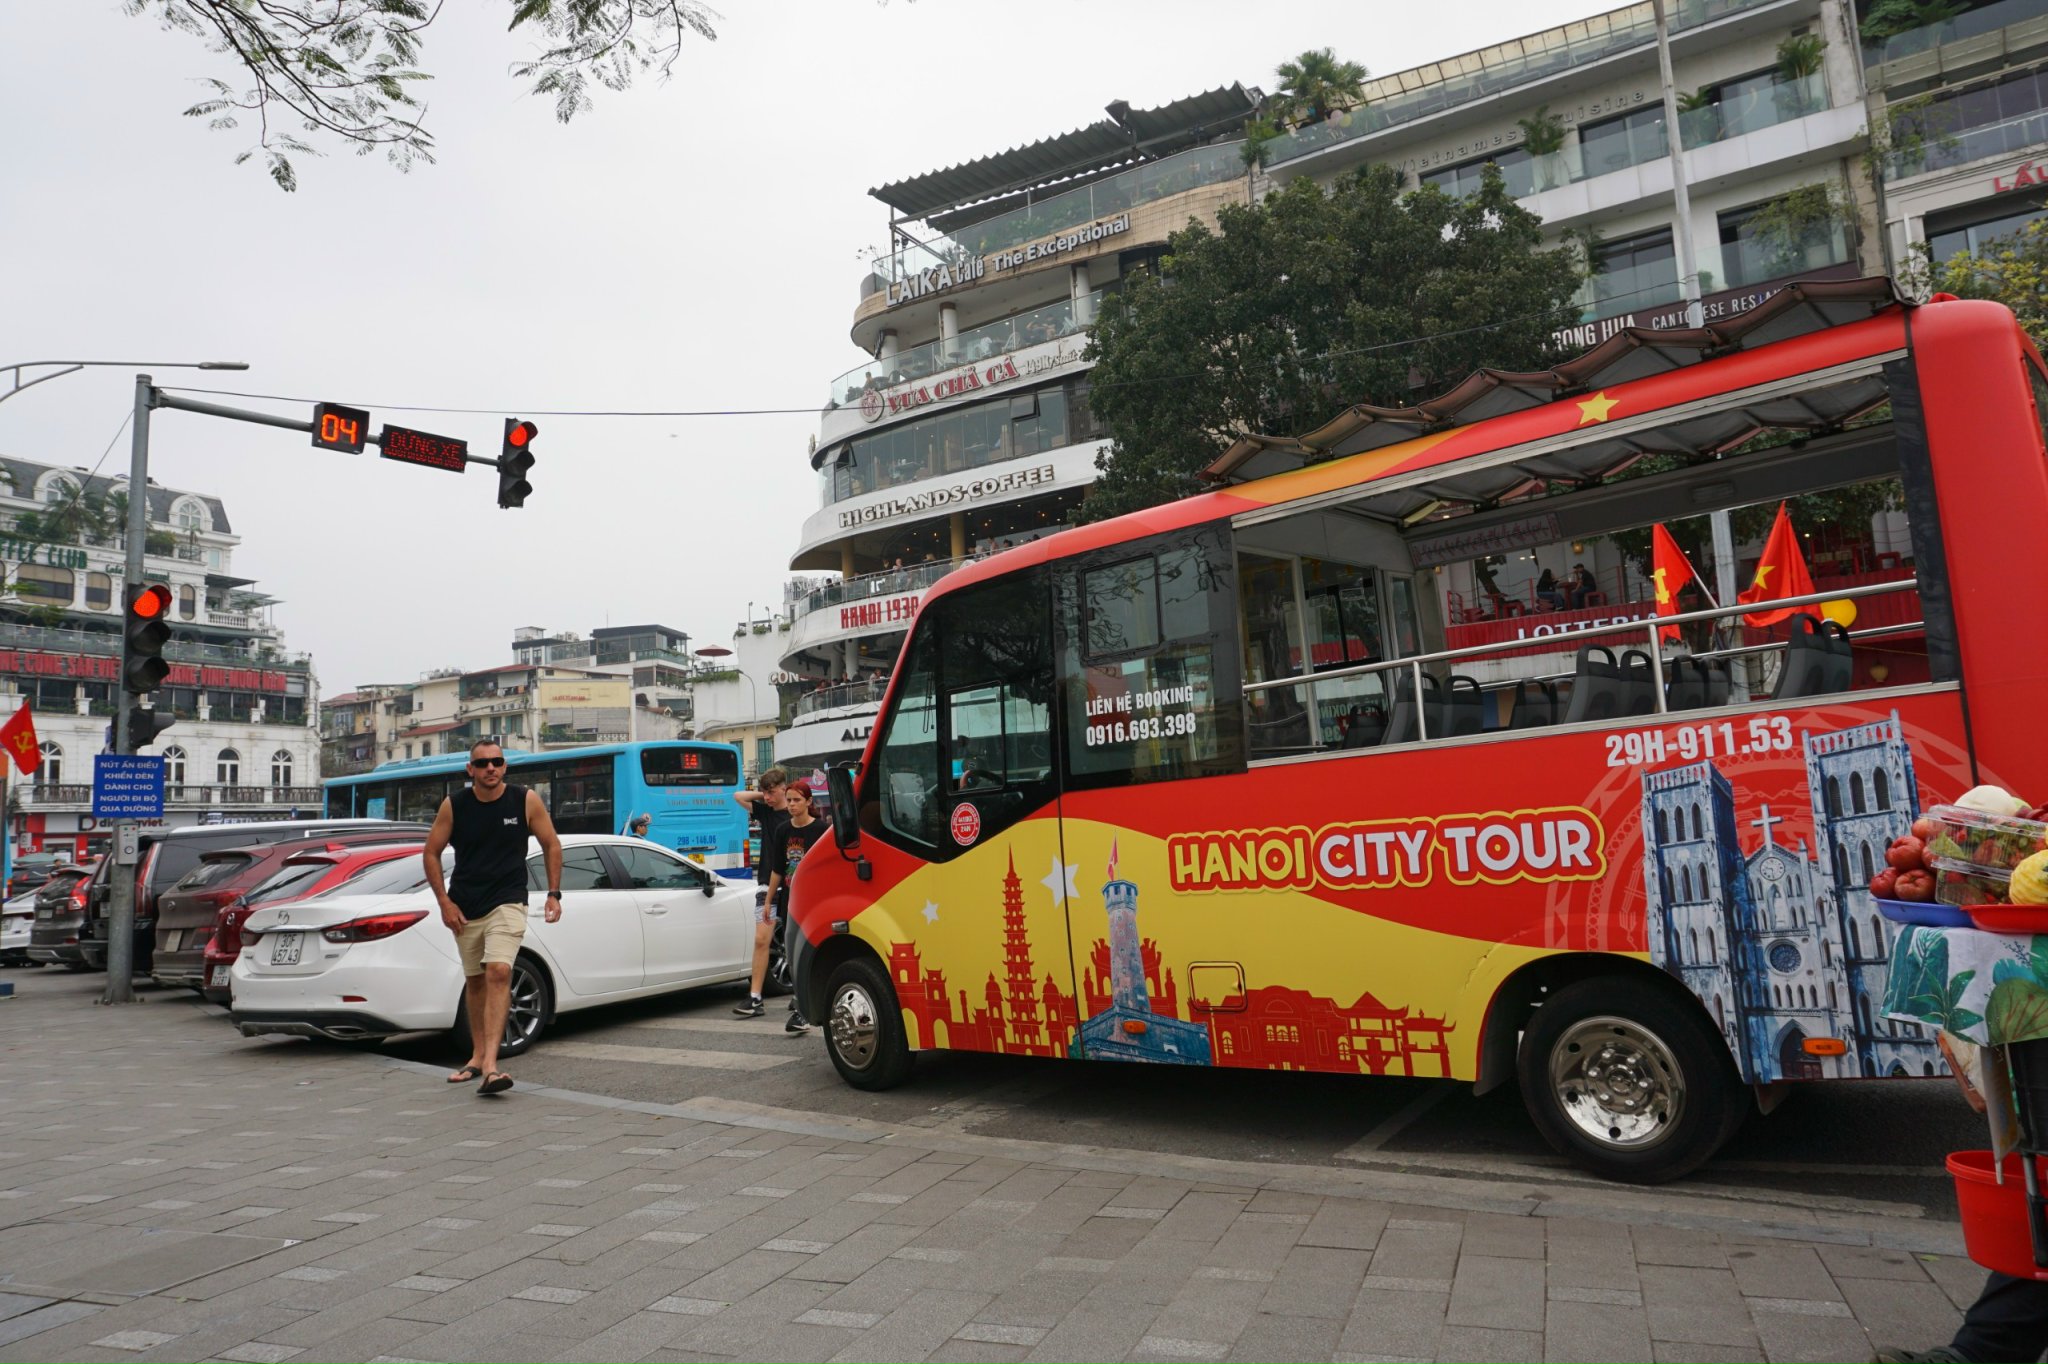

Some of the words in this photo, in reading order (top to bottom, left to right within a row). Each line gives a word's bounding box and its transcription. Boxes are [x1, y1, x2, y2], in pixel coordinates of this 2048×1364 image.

[1556, 90, 1644, 122] uisine
[886, 264, 953, 307] LAIKA
[956, 256, 985, 285] Café
[992, 251, 1024, 272] The
[1026, 213, 1130, 261] Exceptional
[1652, 302, 1725, 330] CANTOESE
[887, 384, 931, 414] VUA
[986, 356, 1021, 384] CÁ
[321, 414, 358, 445] 04
[440, 440, 463, 461] XE
[839, 485, 963, 528] HIGHLANDS
[967, 464, 1055, 499] COFFEE
[47, 545, 88, 569] CLUB
[841, 602, 882, 629] HANOI
[1086, 691, 1113, 717] LIÊN
[1116, 690, 1133, 714] HỆ
[1136, 684, 1194, 711] BOOKING
[1086, 711, 1197, 747] 0916.693.398
[1605, 715, 1794, 767] 29H-911.53
[100, 761, 119, 769] NÚT
[104, 783, 131, 791] DÀNH
[1174, 837, 1307, 883] HANOI
[1318, 829, 1428, 878] CITY
[1444, 819, 1592, 873] TOUR
